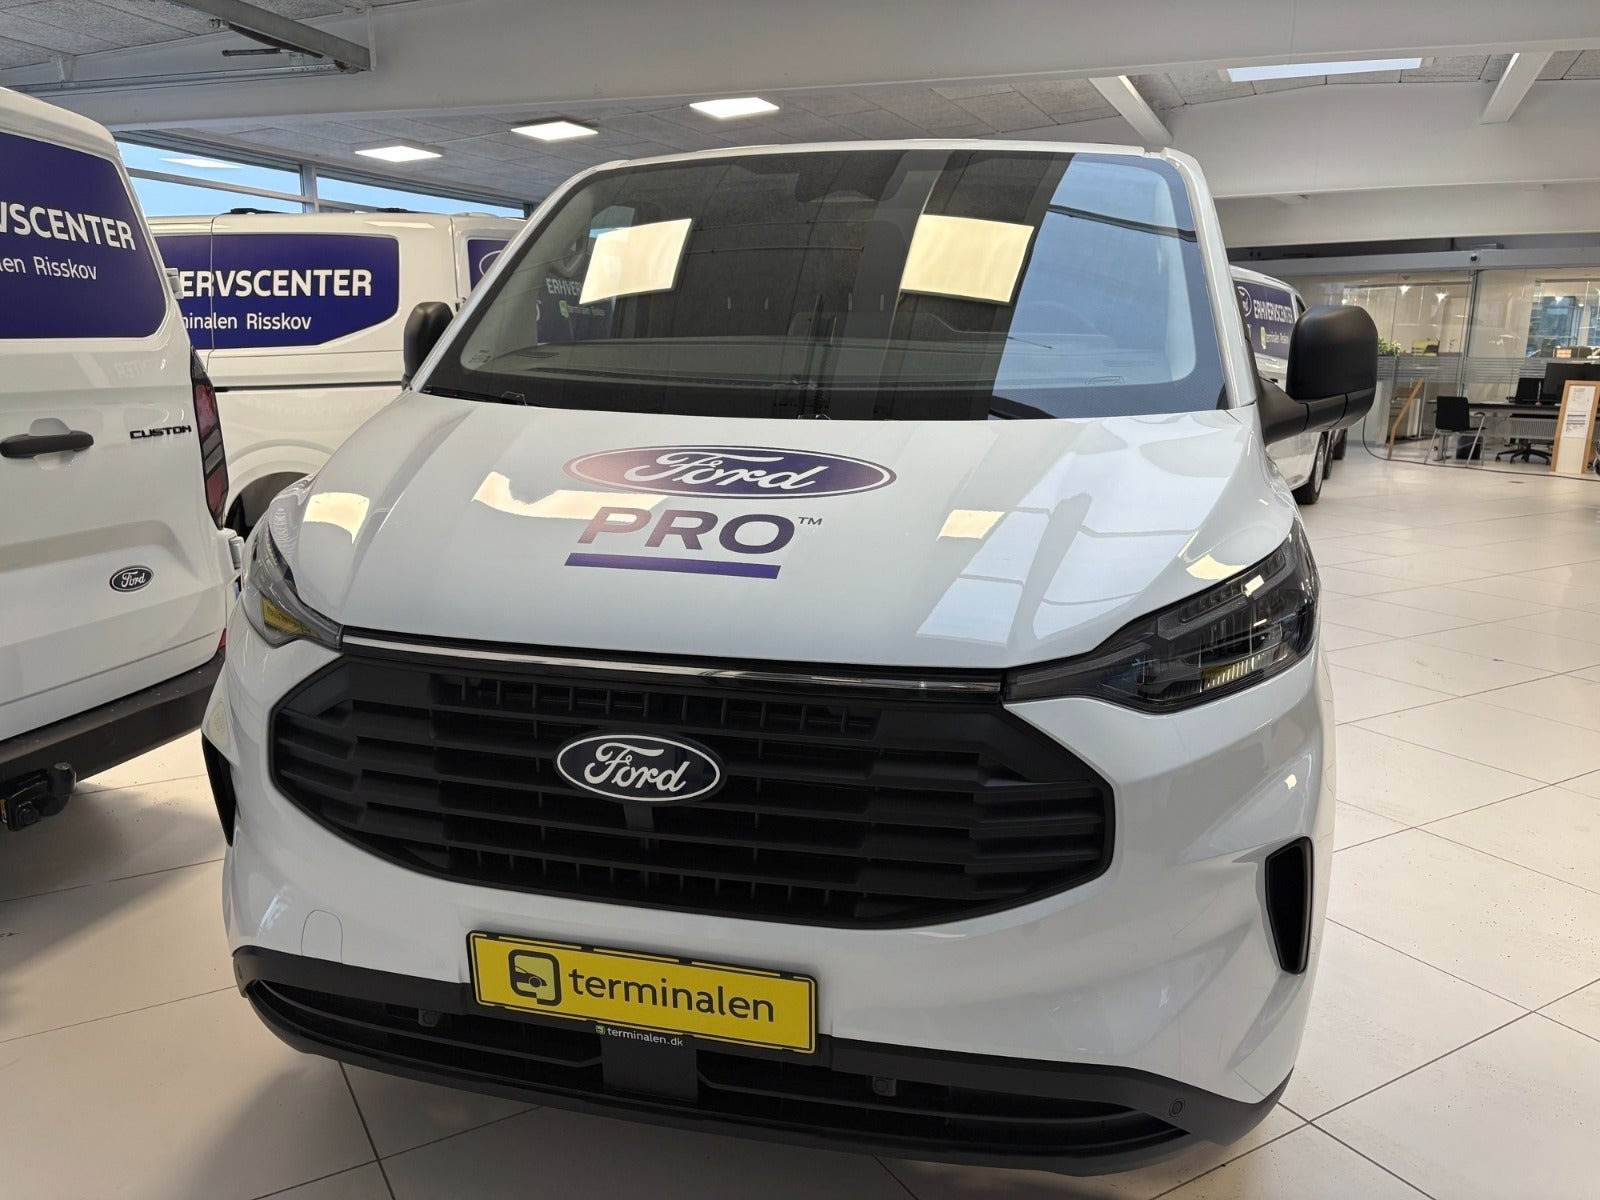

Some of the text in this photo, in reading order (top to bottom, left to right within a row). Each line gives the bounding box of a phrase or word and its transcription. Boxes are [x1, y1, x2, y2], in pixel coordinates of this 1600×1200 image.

[33, 255, 97, 280] Risskov
[179, 268, 372, 297] ERVSCENTER
[246, 312, 312, 331] Risskov
[129, 424, 192, 439] CUSTOM
[623, 451, 829, 490] Ford
[577, 506, 796, 555] PRO
[120, 570, 147, 588] Ford
[583, 742, 691, 792] Ford
[568, 968, 775, 1023] terminalen
[606, 1026, 684, 1047] terminalen.dk
